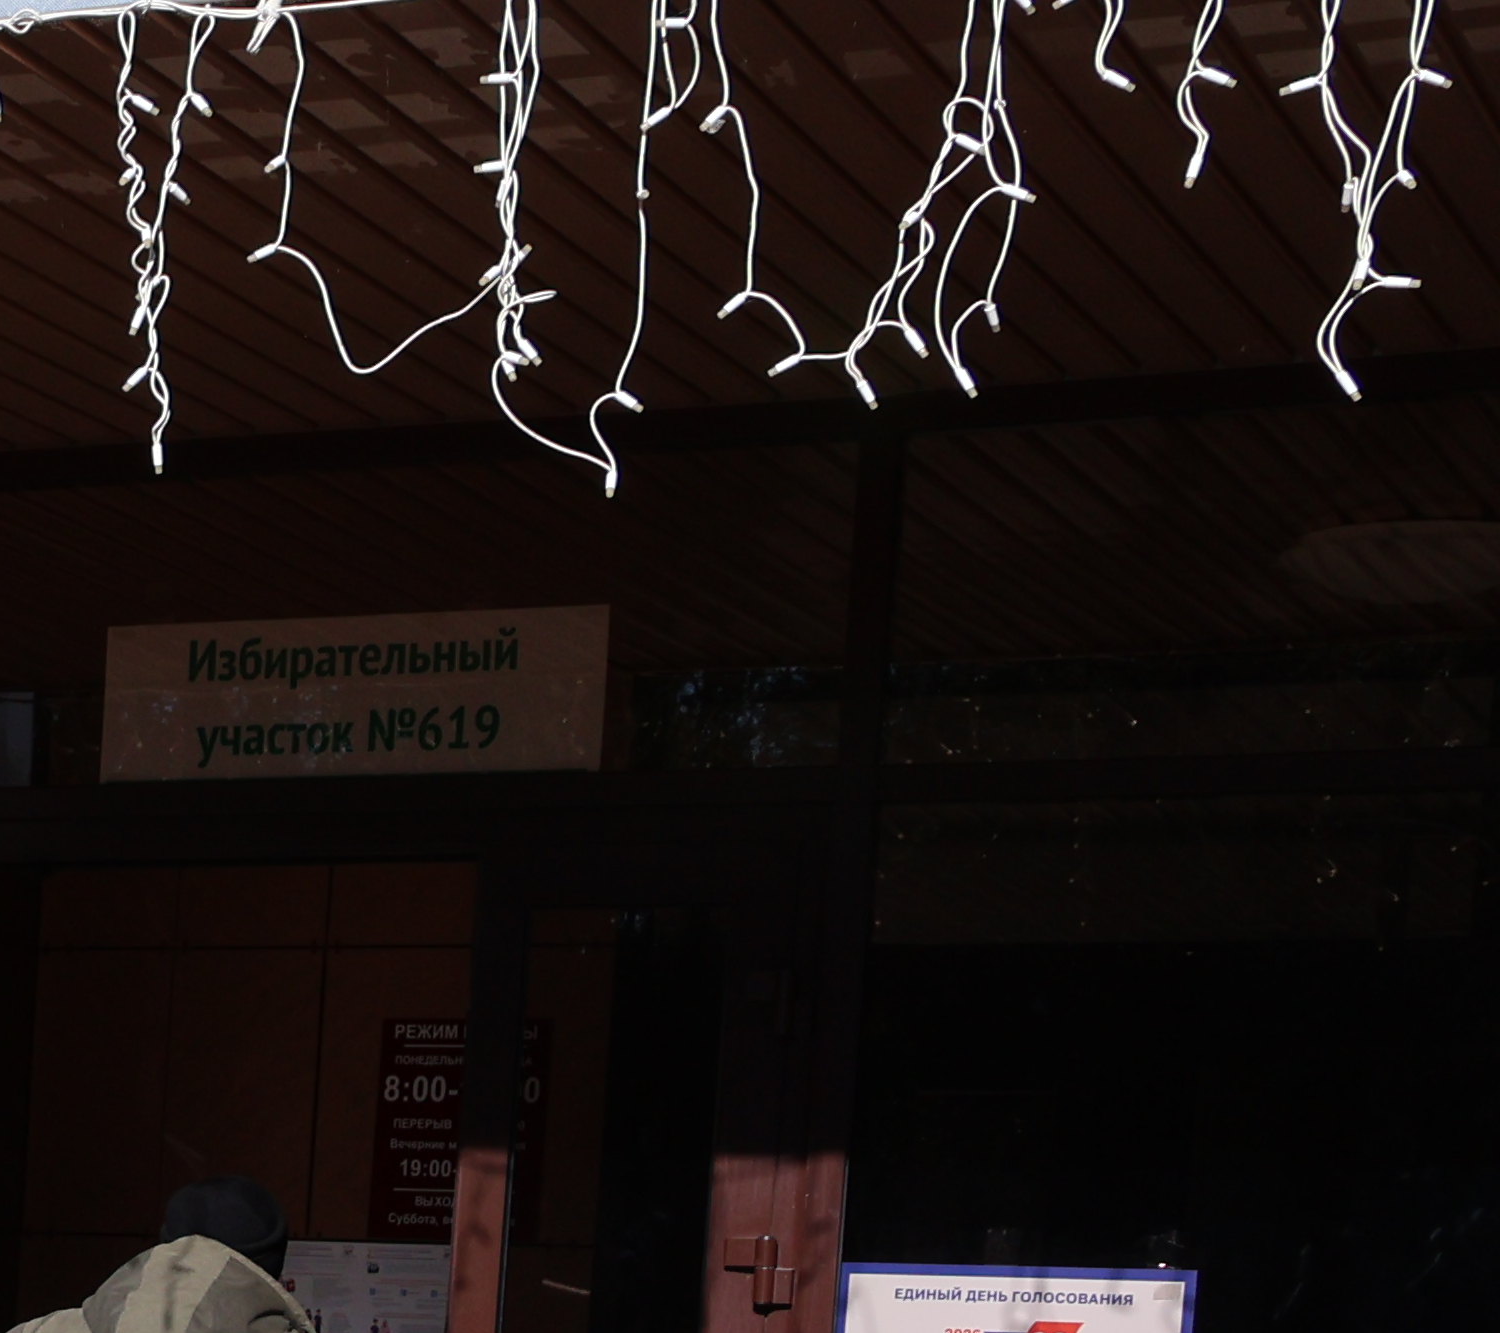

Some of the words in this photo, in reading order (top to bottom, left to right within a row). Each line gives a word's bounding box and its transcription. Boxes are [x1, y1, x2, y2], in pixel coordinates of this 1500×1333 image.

[188, 627, 519, 690] Избирательный
[195, 720, 353, 768] участок
[366, 704, 501, 753] №619
[394, 1024, 459, 1040] РЕЖИМ
[394, 1054, 464, 1066] ПОНЕДЕЛЬН
[393, 1118, 453, 1130] ПЕРЕРЫВ
[894, 1286, 962, 1302] ЕДИНЫЙ
[966, 1290, 1007, 1303] ДЕНЬ
[1012, 1291, 1134, 1306] ГОЛОСОВАНИЯ
